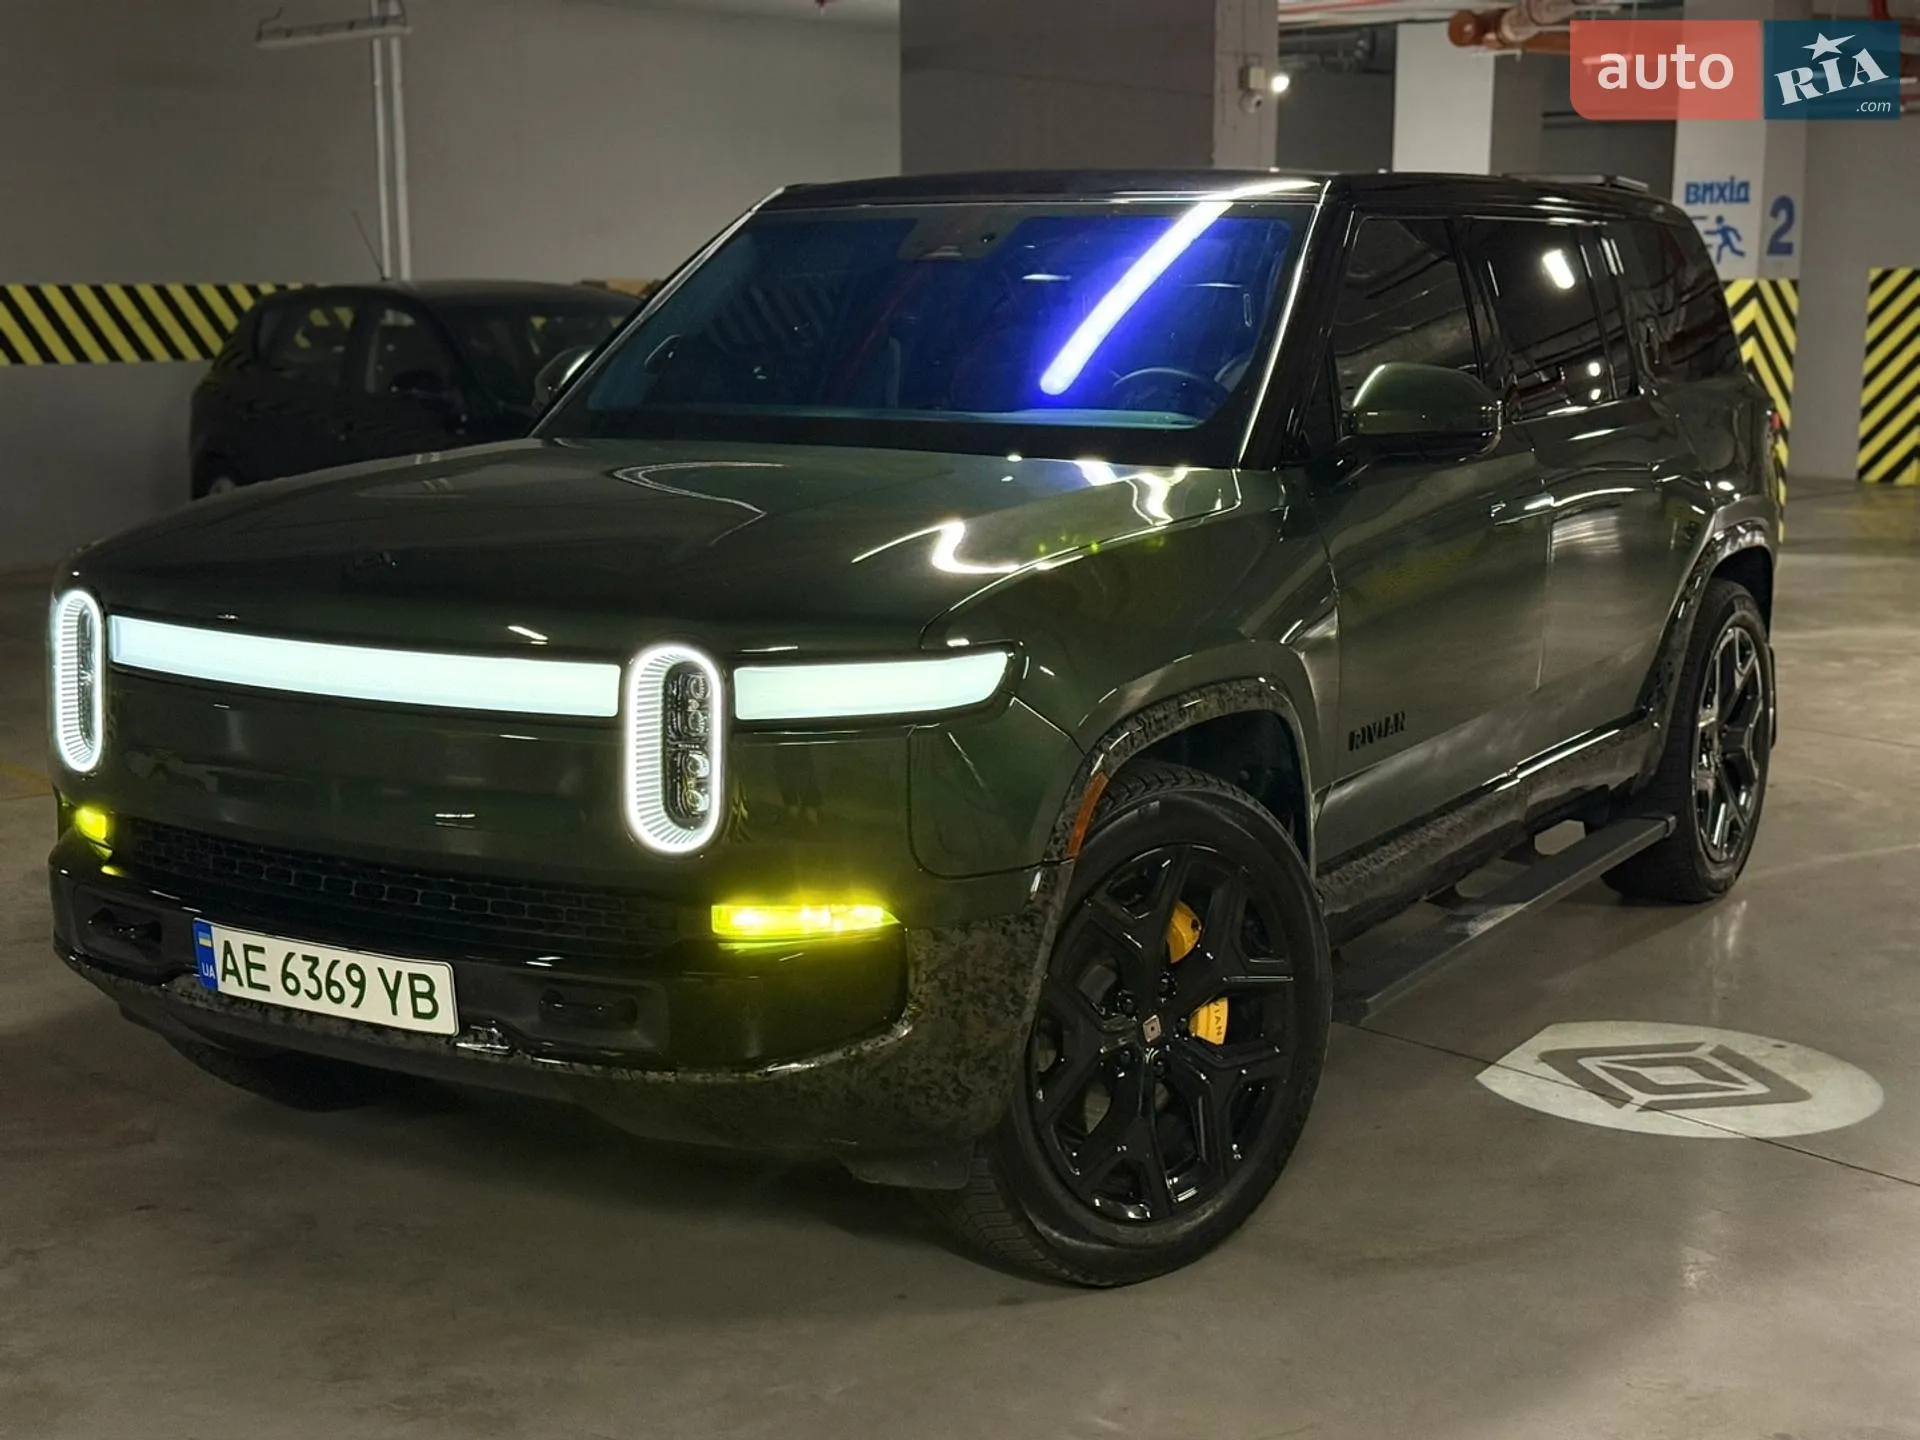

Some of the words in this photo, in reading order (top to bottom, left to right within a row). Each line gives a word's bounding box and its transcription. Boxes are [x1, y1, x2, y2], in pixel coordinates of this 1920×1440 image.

[1765, 194, 1796, 257] 2
[201, 961, 216, 980] UA
[221, 940, 271, 992] AE
[281, 951, 367, 1009] 6369
[377, 966, 440, 1020] YB
